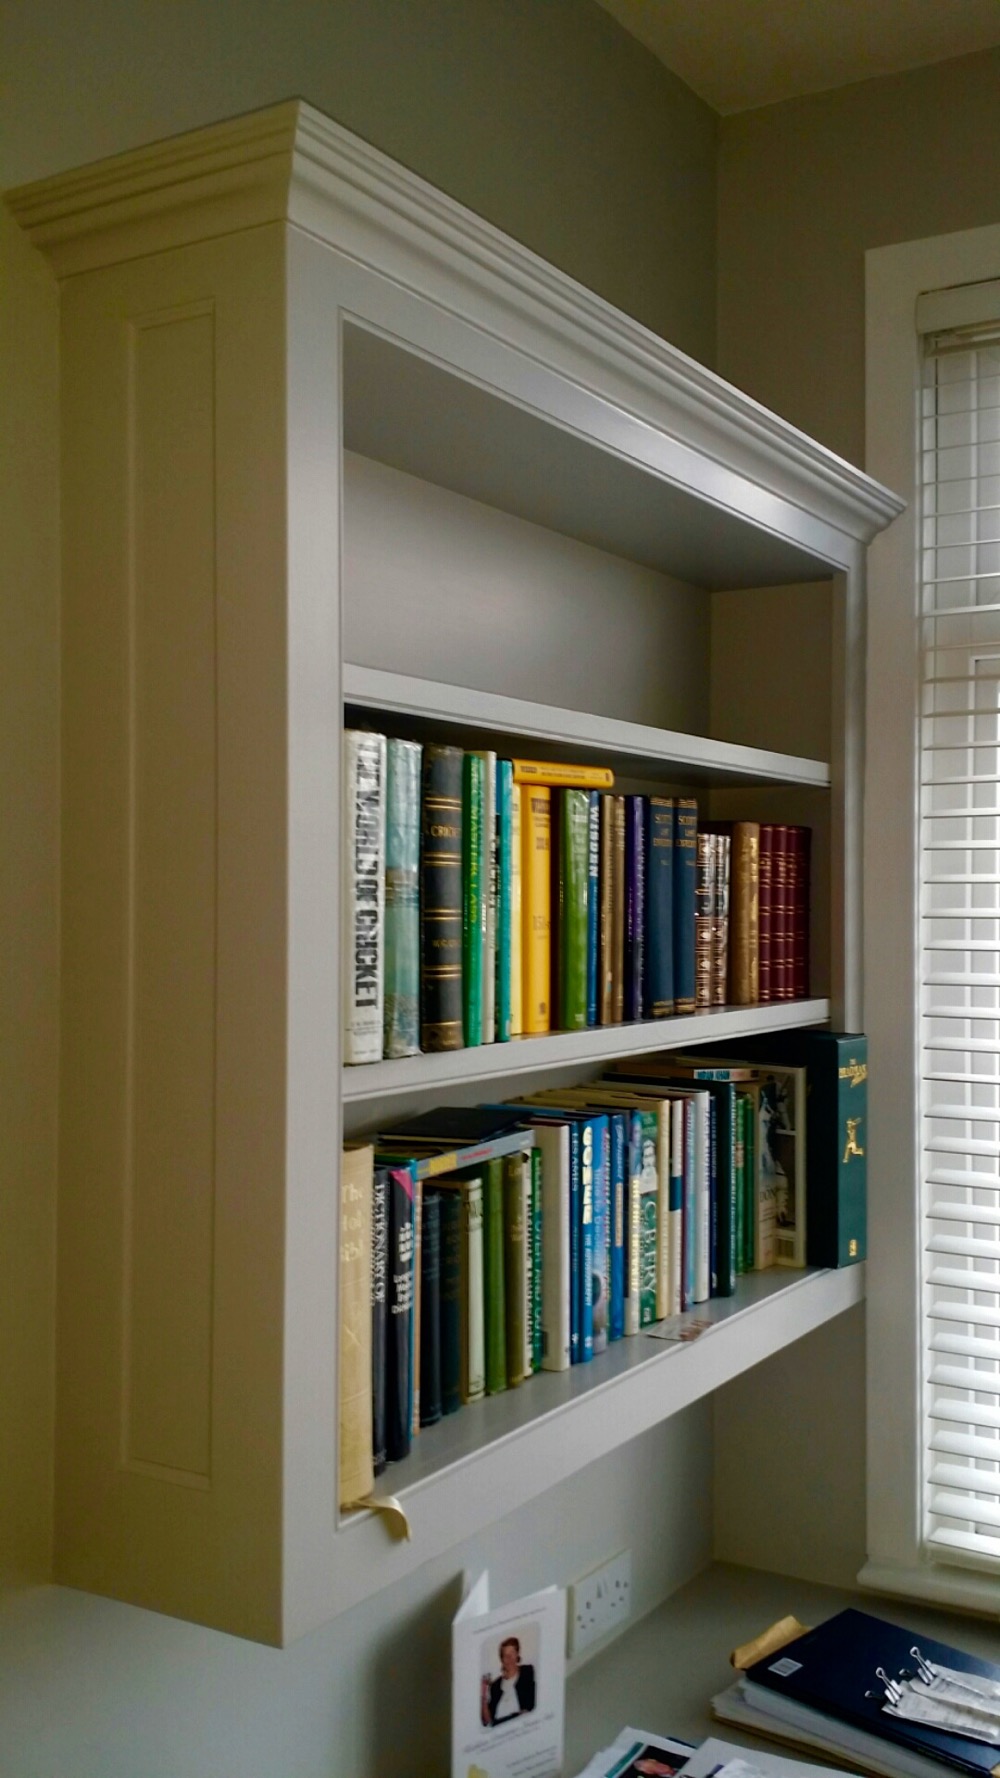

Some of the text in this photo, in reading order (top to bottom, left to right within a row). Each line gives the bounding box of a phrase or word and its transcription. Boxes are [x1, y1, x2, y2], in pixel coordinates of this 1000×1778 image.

[355, 742, 381, 1009] THE WORLD OF CRICKET
[589, 806, 599, 877] WISDEN
[571, 1132, 579, 1191] LES AMES
[582, 1126, 593, 1224] GOWER
[374, 1184, 386, 1303] DICTIONARY OF
[644, 1250, 657, 1293] FRY
